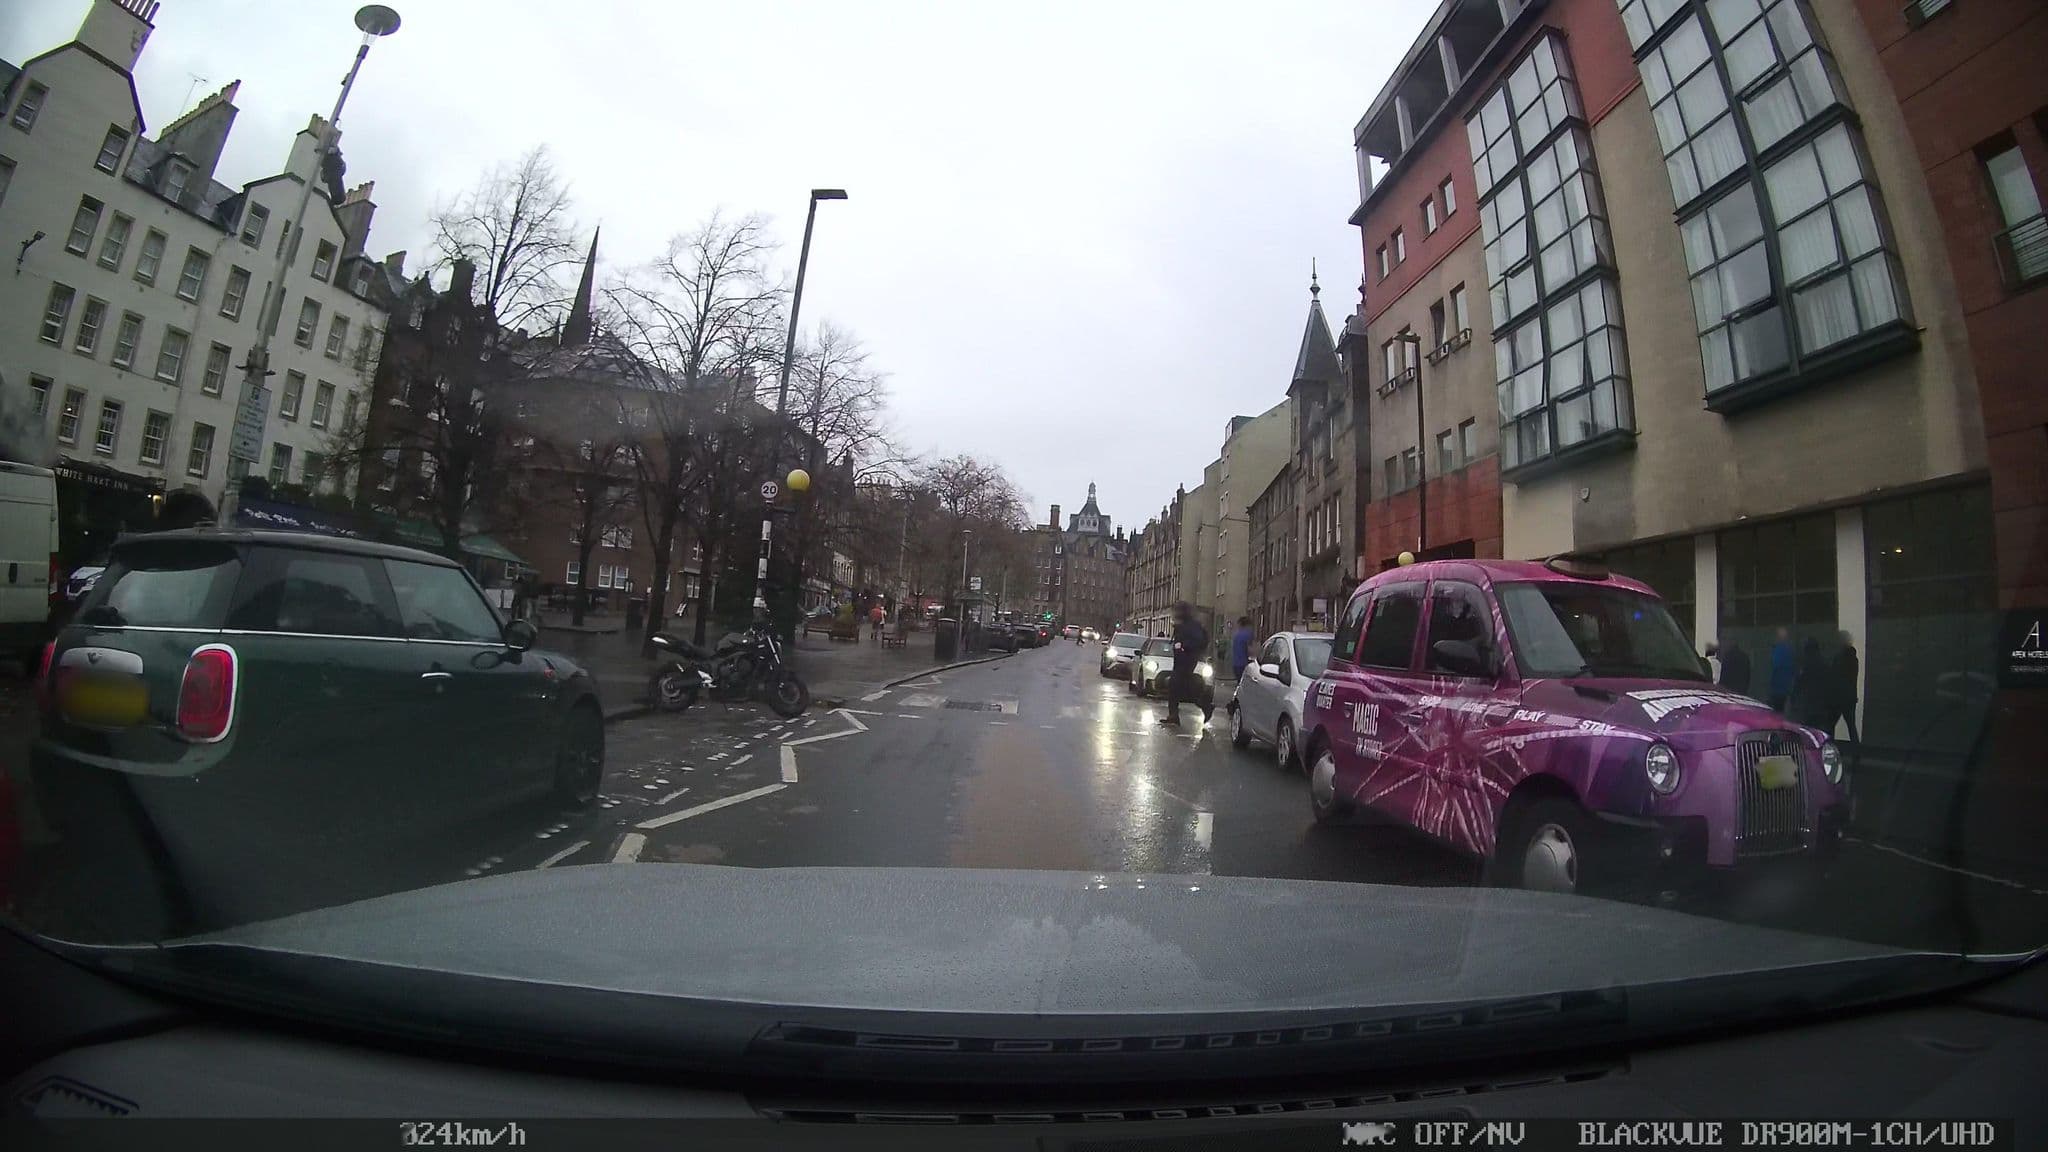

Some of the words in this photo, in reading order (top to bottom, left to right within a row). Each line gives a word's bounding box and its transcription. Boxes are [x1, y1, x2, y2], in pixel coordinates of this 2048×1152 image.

[762, 485, 777, 494] 20
[2021, 620, 2039, 648] A
[1352, 702, 1379, 736] MAGIC
[1514, 709, 1546, 723] PLAY
[1579, 719, 1616, 736] STAY
